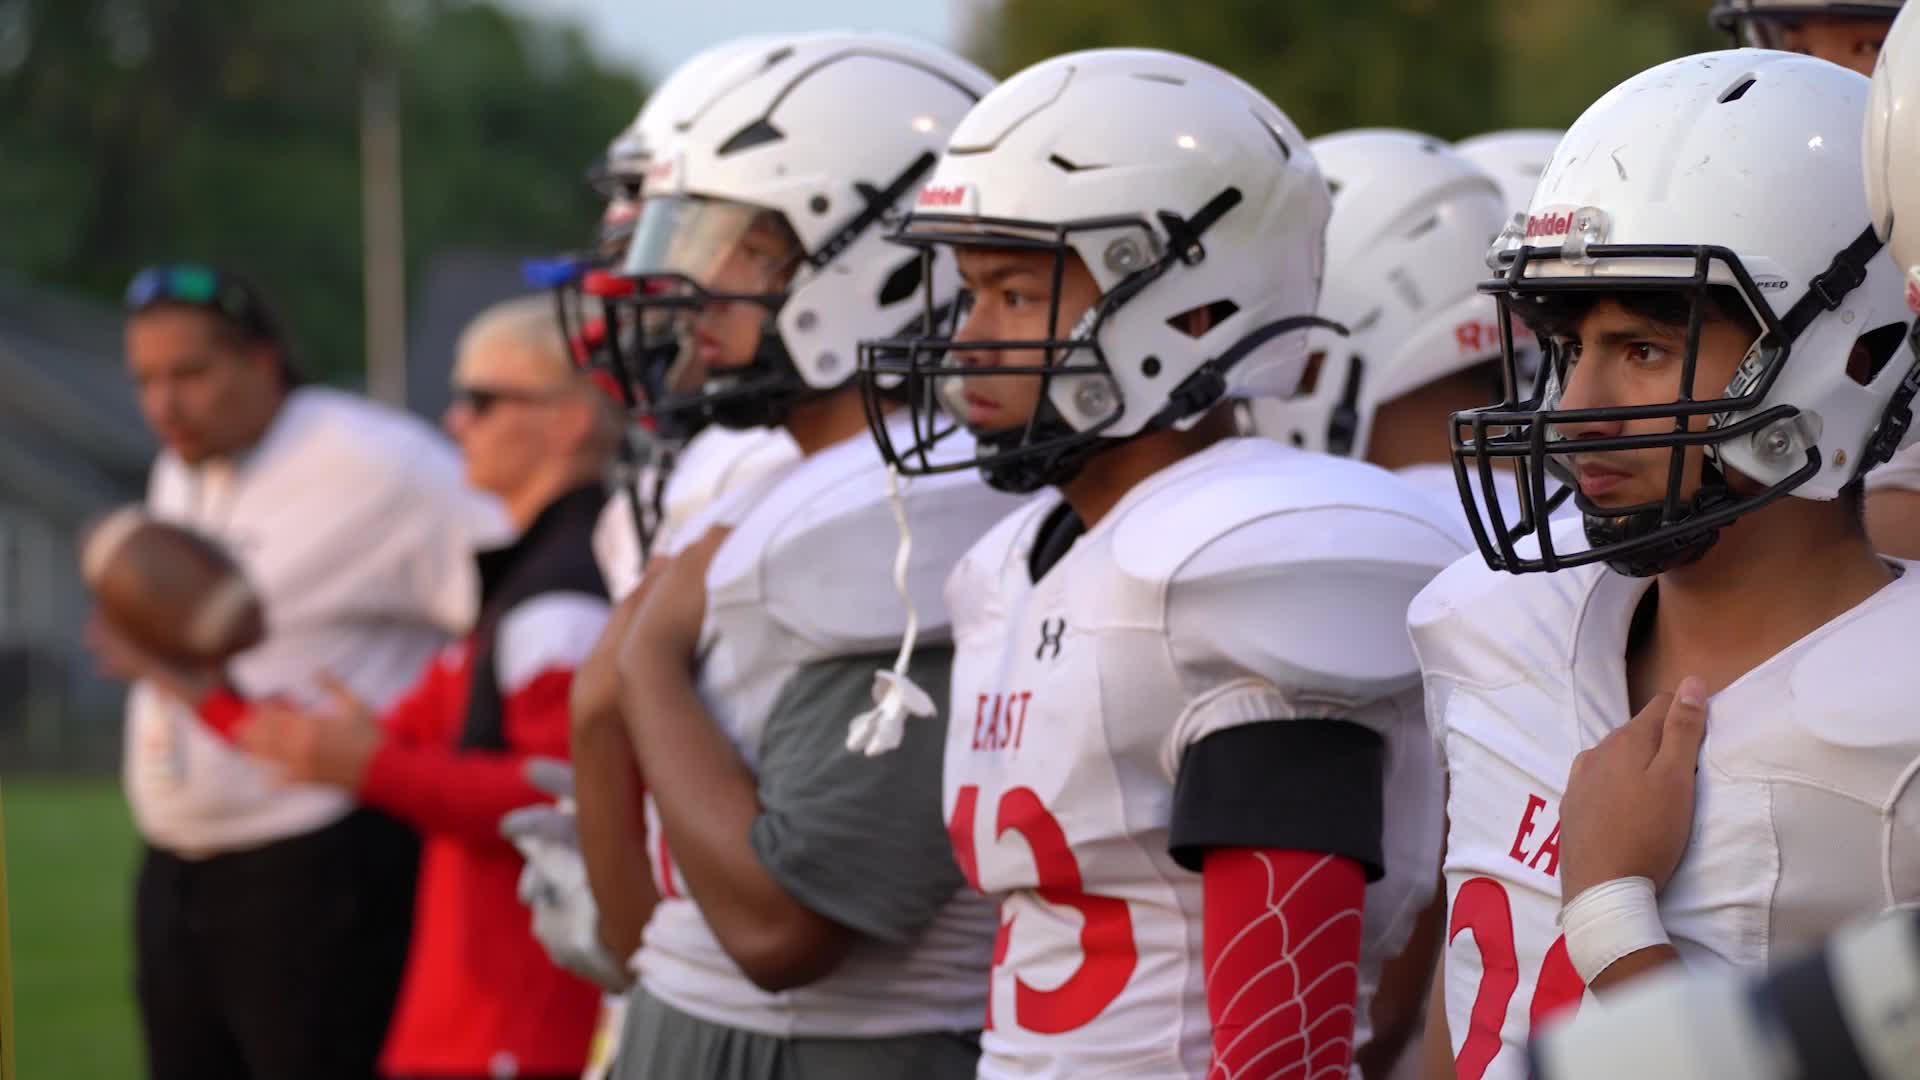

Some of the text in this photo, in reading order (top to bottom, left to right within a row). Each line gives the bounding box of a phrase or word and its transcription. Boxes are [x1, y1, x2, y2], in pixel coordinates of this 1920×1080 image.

[1757, 280, 1788, 289] PEED
[972, 691, 1032, 750] EAST
[1508, 793, 1560, 877] EA
